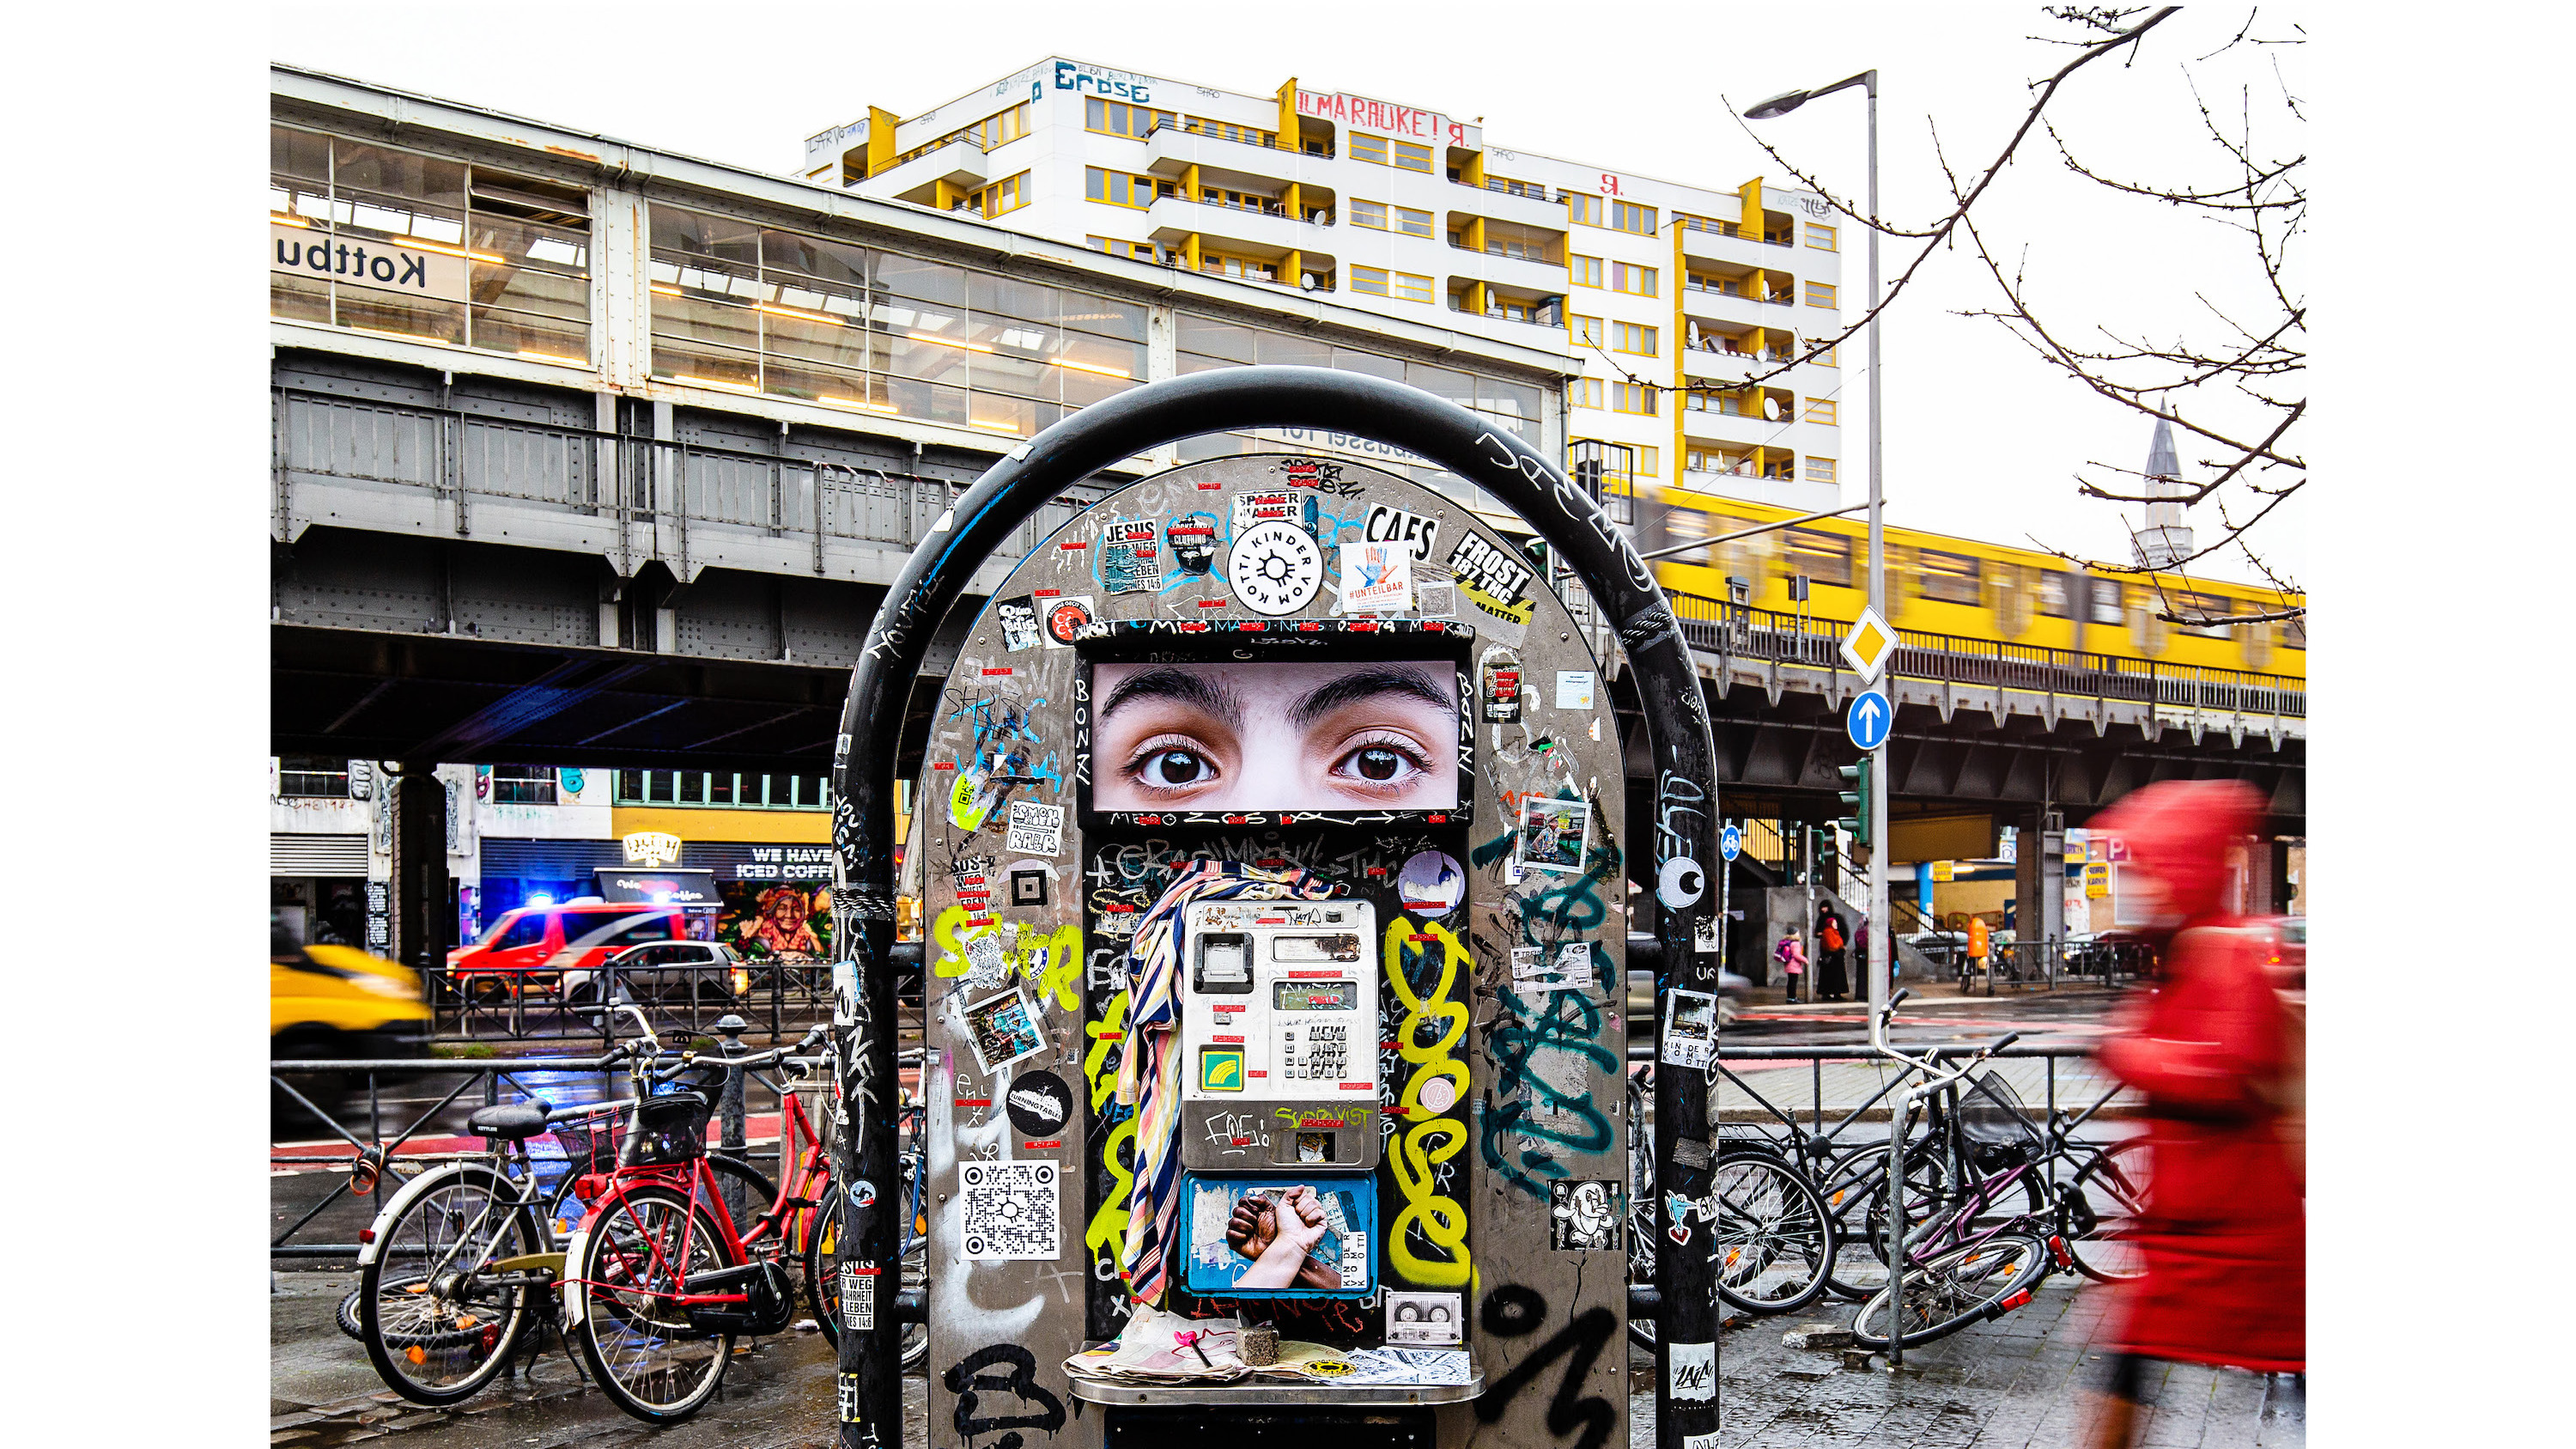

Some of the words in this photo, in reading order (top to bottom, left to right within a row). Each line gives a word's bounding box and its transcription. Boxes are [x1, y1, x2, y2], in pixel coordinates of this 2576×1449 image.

[1107, 522, 1155, 542] JESUS
[1251, 531, 1312, 566] KINDER
[1457, 530, 1531, 591] FROST
[1239, 554, 1269, 604] KOTTI
[1451, 553, 1482, 580] 187
[1479, 572, 1513, 605] THC
[1279, 575, 1311, 605] VOM
[1349, 581, 1404, 600] #UNTEILBAR
[751, 848, 782, 862] WE
[2110, 838, 2124, 859] P
[736, 864, 778, 878] ICED
[617, 879, 642, 890] We
[849, 1279, 872, 1290] WEG
[846, 1302, 872, 1313] LEBEN
[859, 1316, 872, 1328] 14:6
